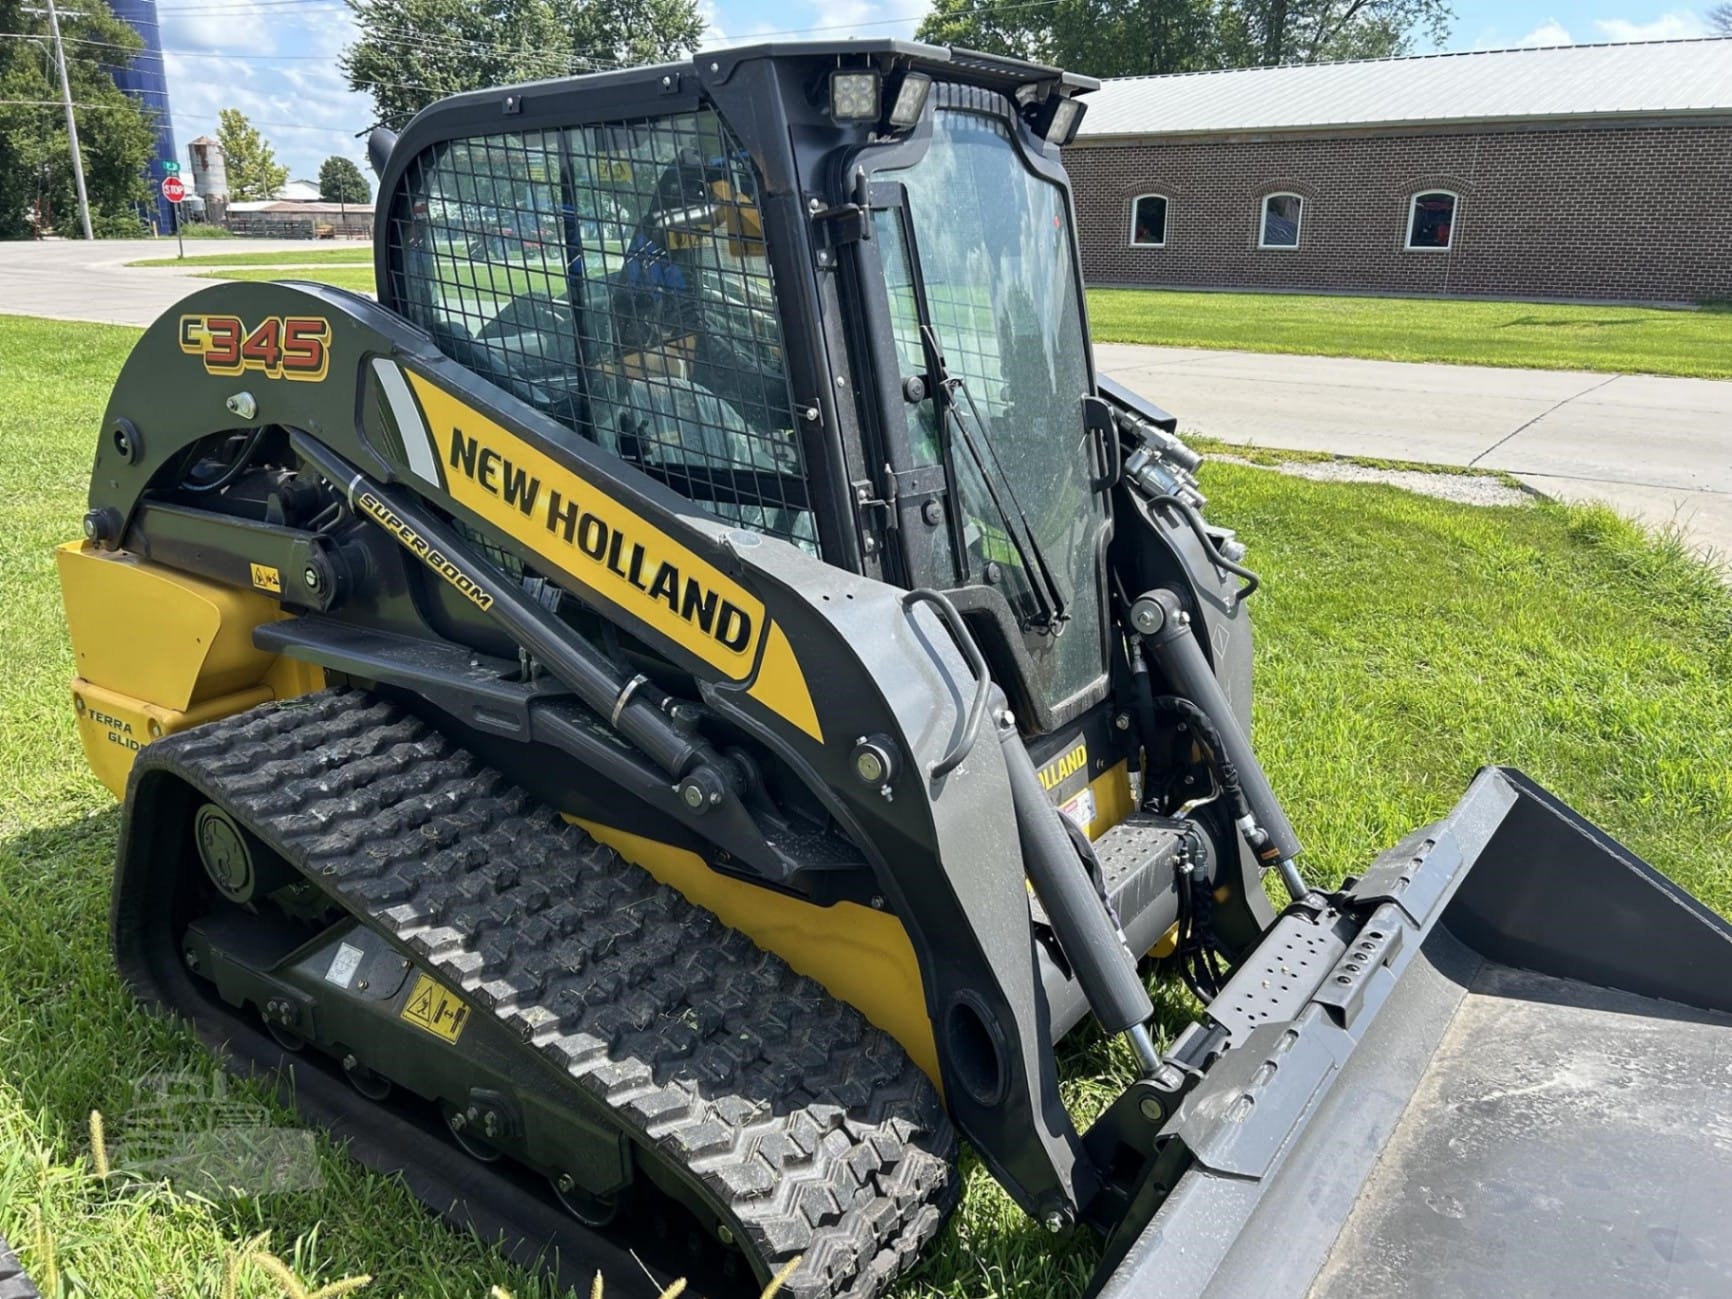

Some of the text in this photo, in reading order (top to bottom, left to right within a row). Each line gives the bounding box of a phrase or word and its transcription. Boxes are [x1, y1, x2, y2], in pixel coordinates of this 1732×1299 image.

[163, 184, 185, 195] STOP
[179, 314, 332, 382] C345
[360, 492, 494, 611] SUPER BOOM
[449, 426, 753, 653] NEW HOLLAND
[88, 708, 133, 734] TERRA
[107, 731, 146, 751] GLID
